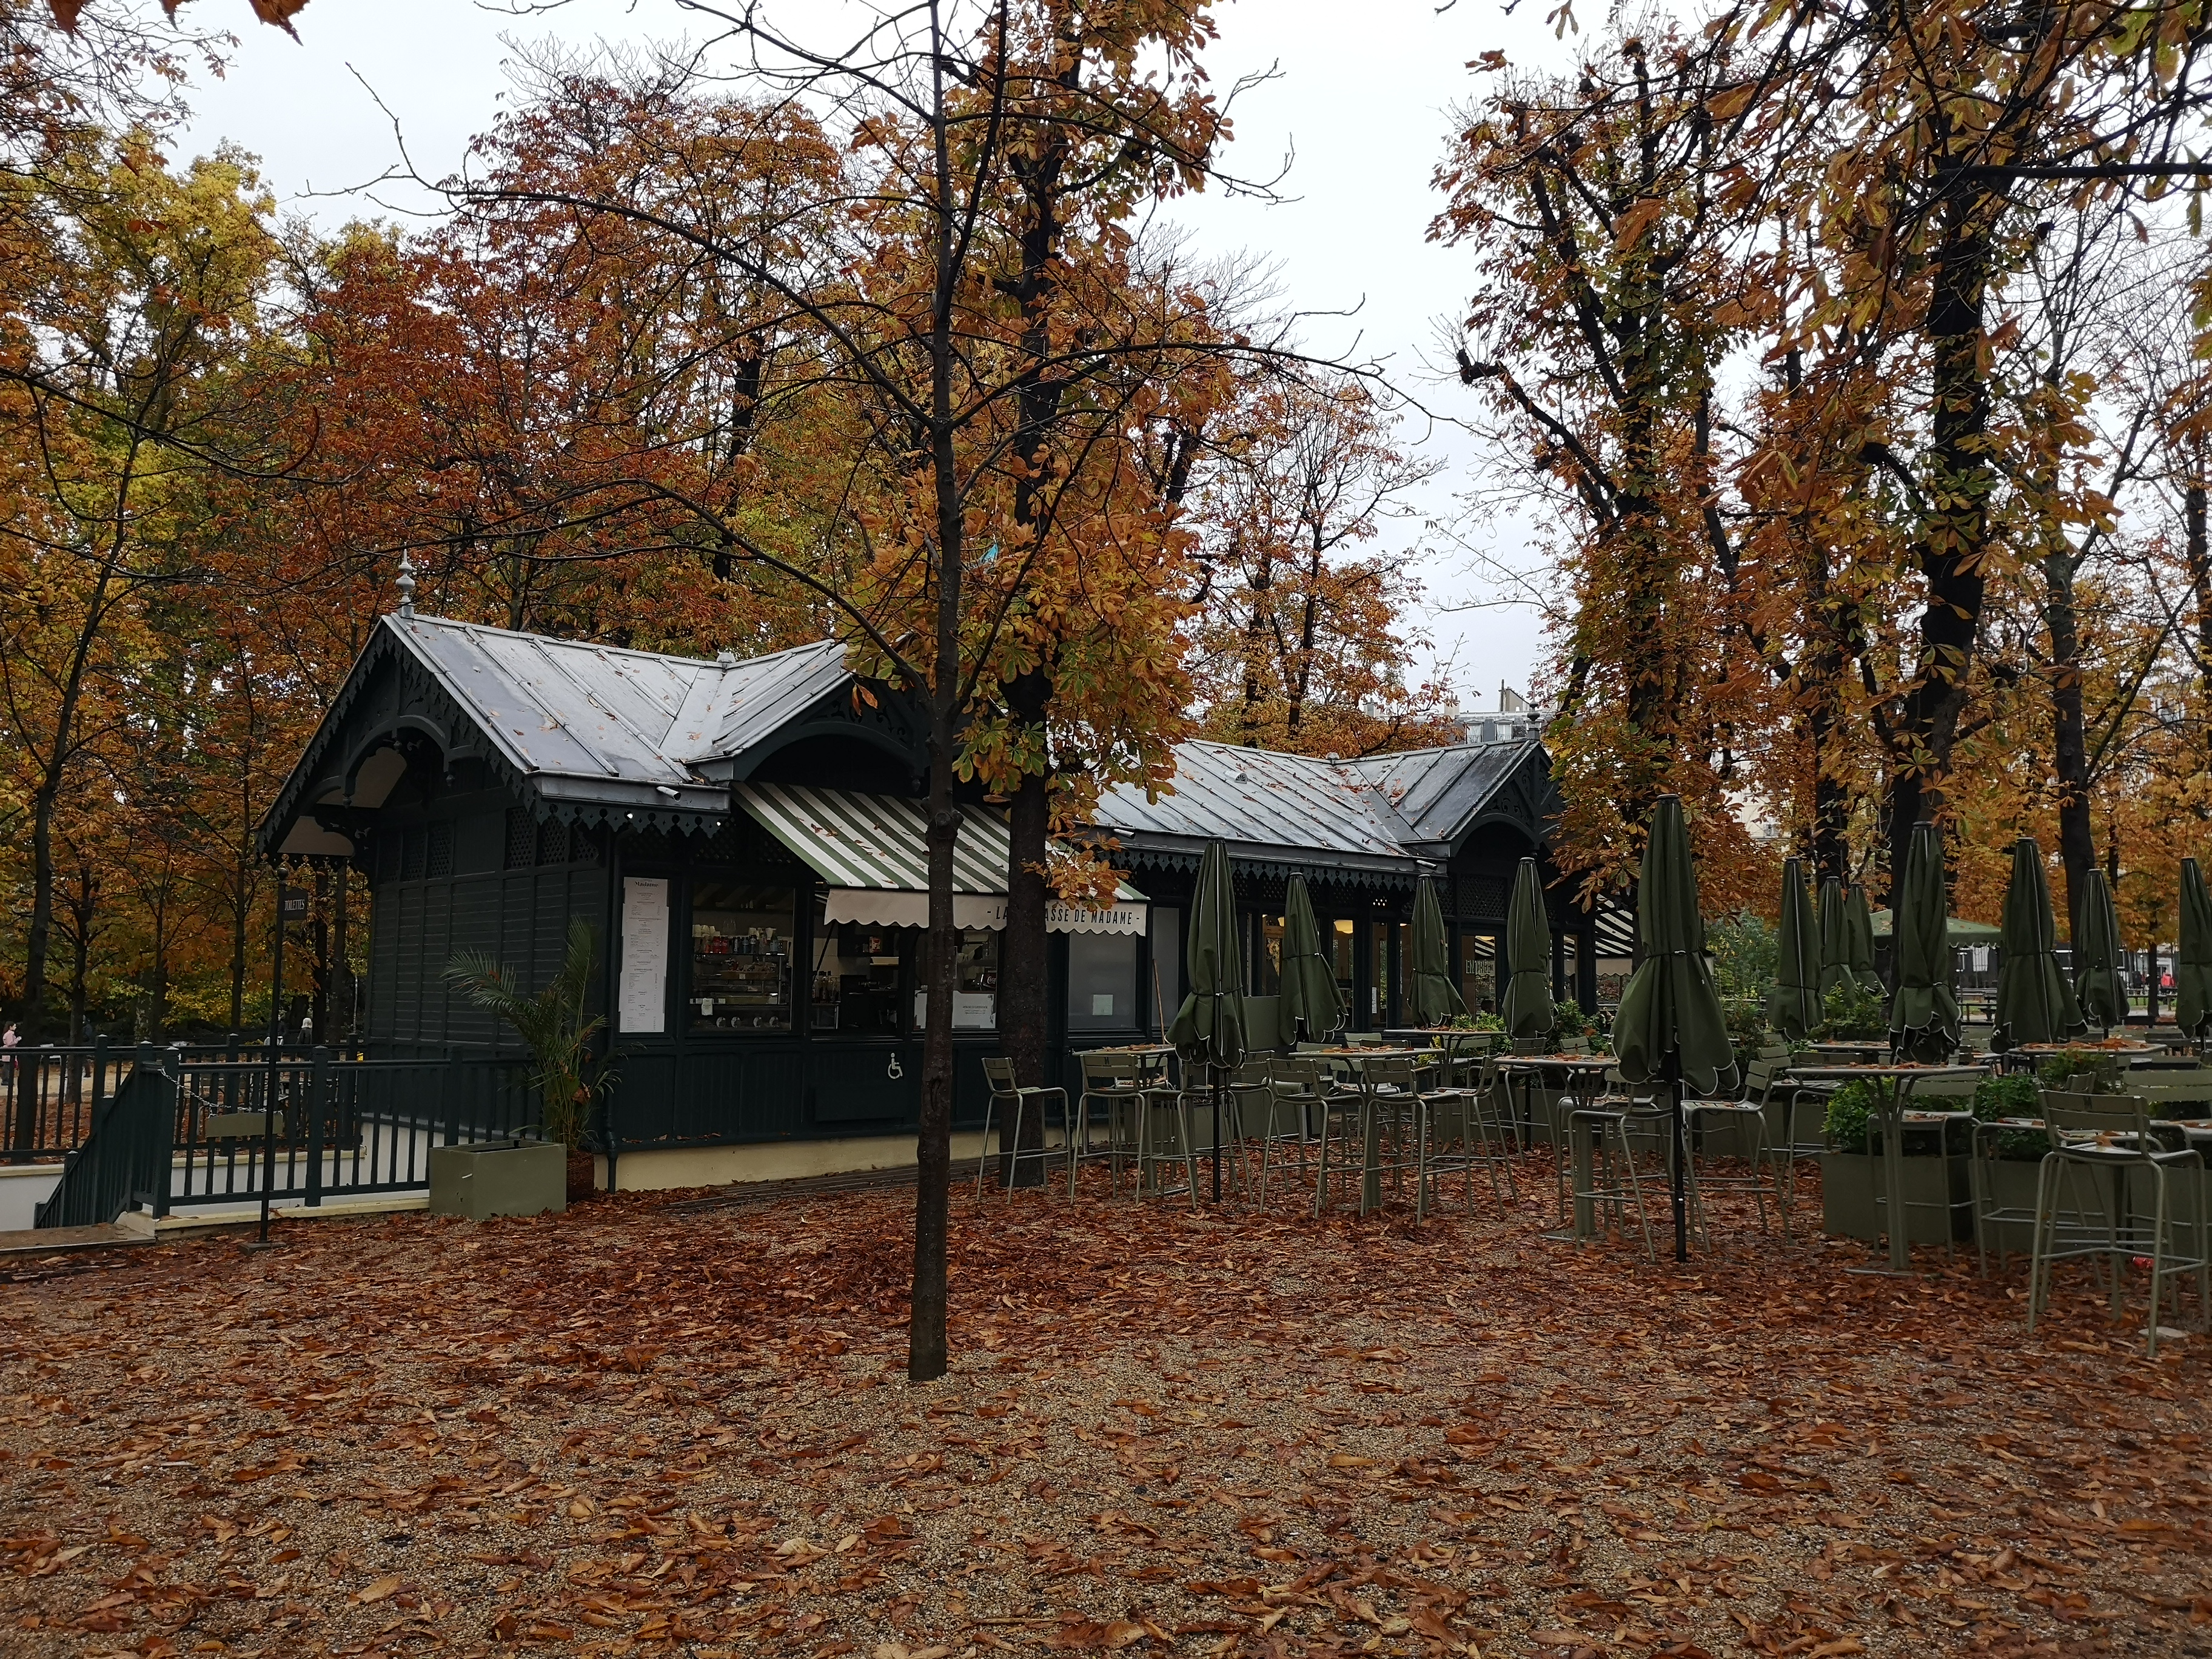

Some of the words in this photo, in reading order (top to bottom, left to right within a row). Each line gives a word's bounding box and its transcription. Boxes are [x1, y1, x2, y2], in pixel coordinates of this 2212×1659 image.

[284, 899, 305, 911] TOILETTES
[996, 906, 1009, 920] LA
[1045, 908, 1069, 922] ASSE
[1074, 909, 1086, 923] DE
[1091, 910, 1132, 925] MADAME
